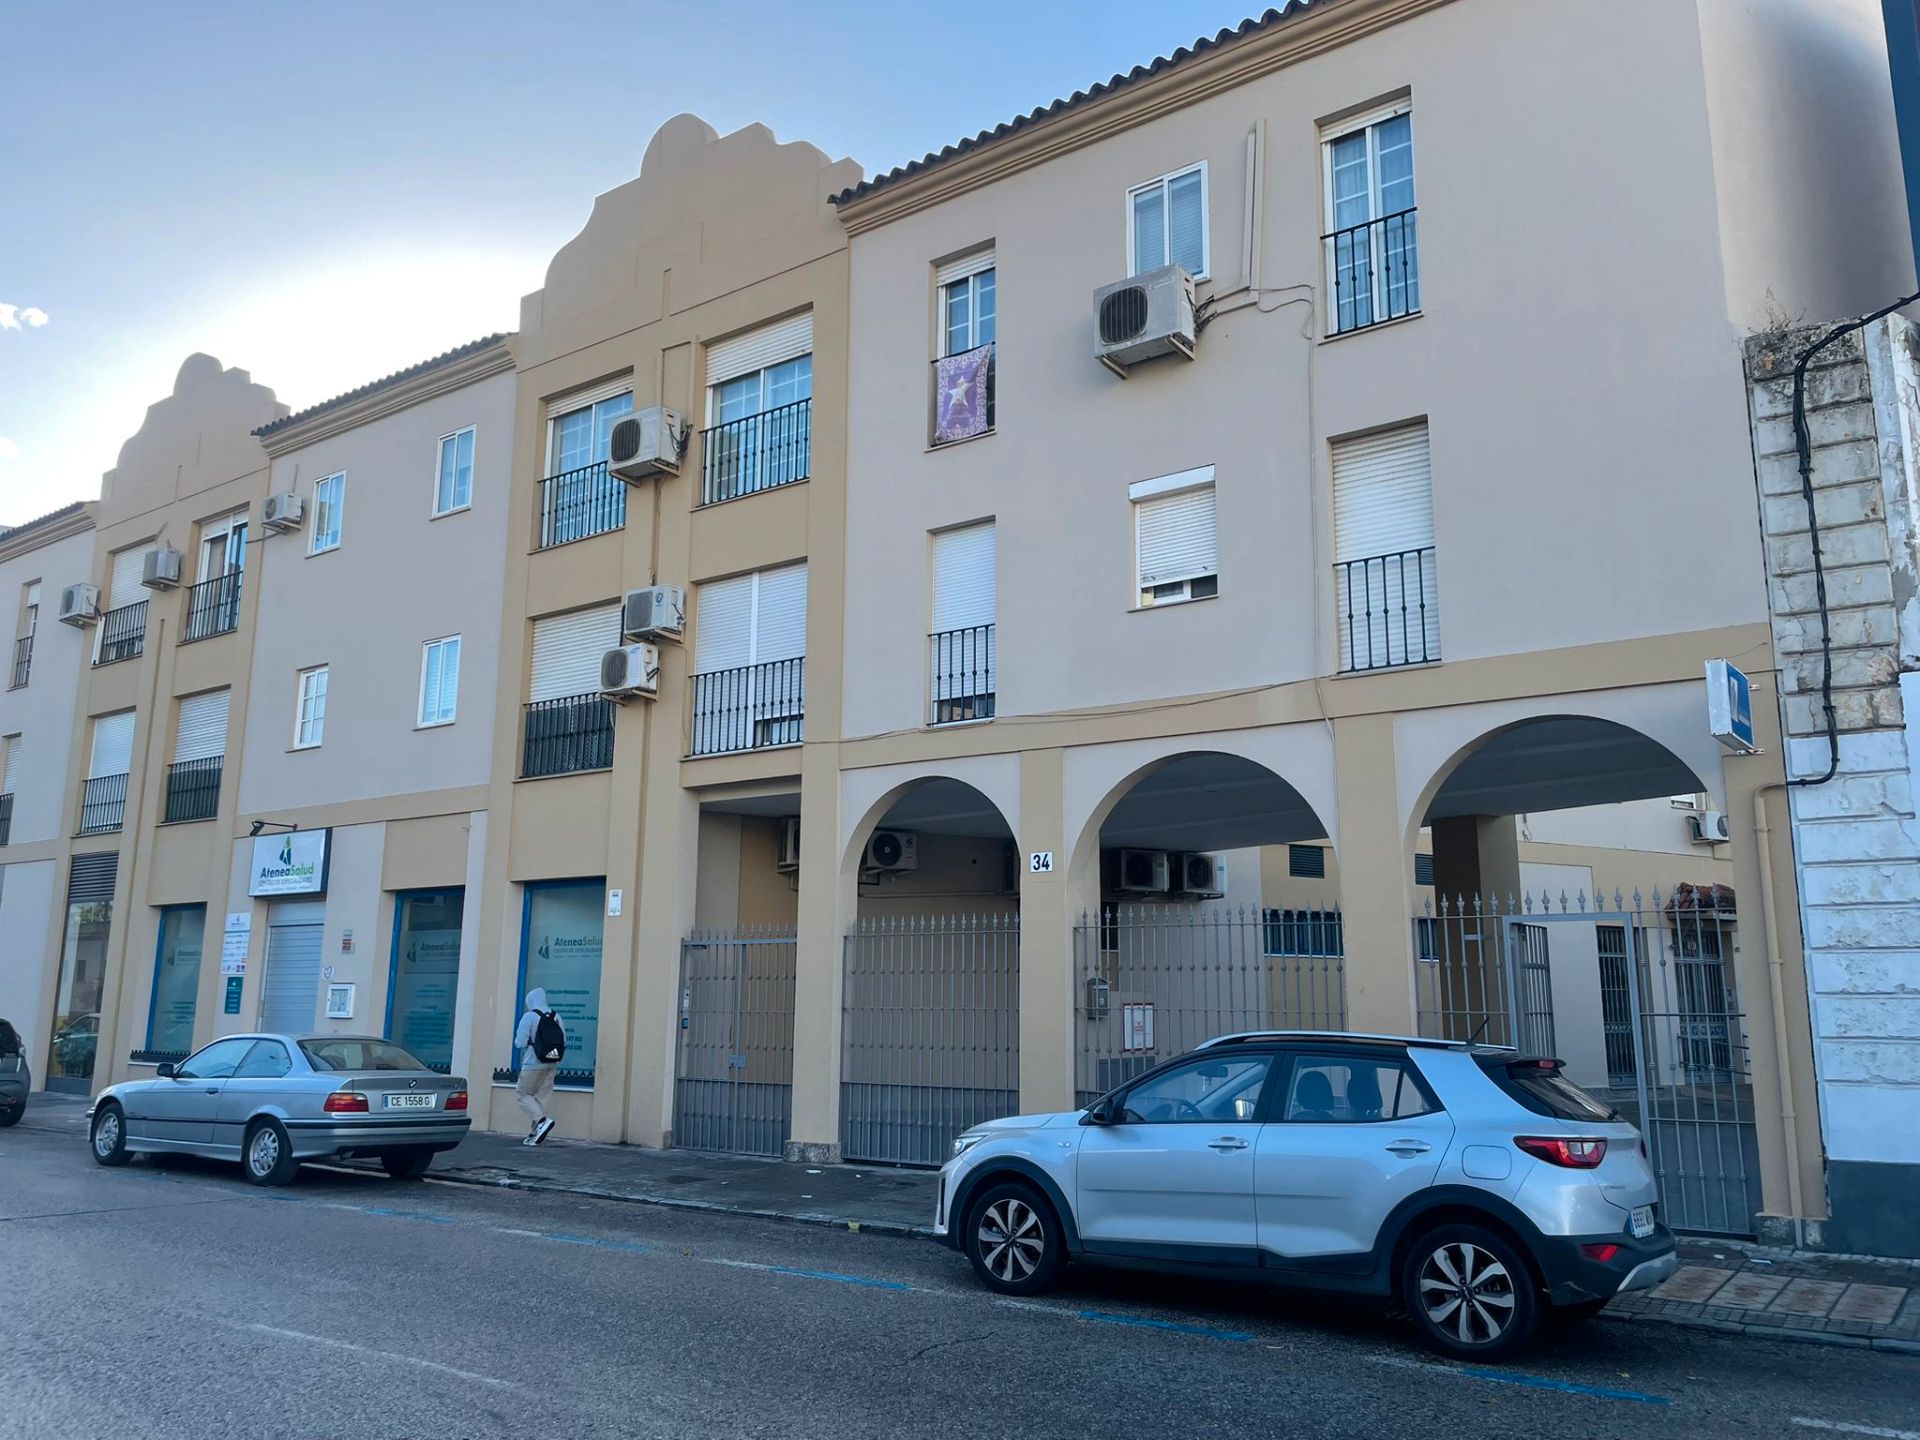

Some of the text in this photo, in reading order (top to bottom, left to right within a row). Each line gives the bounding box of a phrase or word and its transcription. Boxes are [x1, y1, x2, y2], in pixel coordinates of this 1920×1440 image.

[260, 862, 314, 878] AteneaSalud
[1033, 854, 1050, 871] 34
[391, 1096, 430, 1107] CE 1558 G
